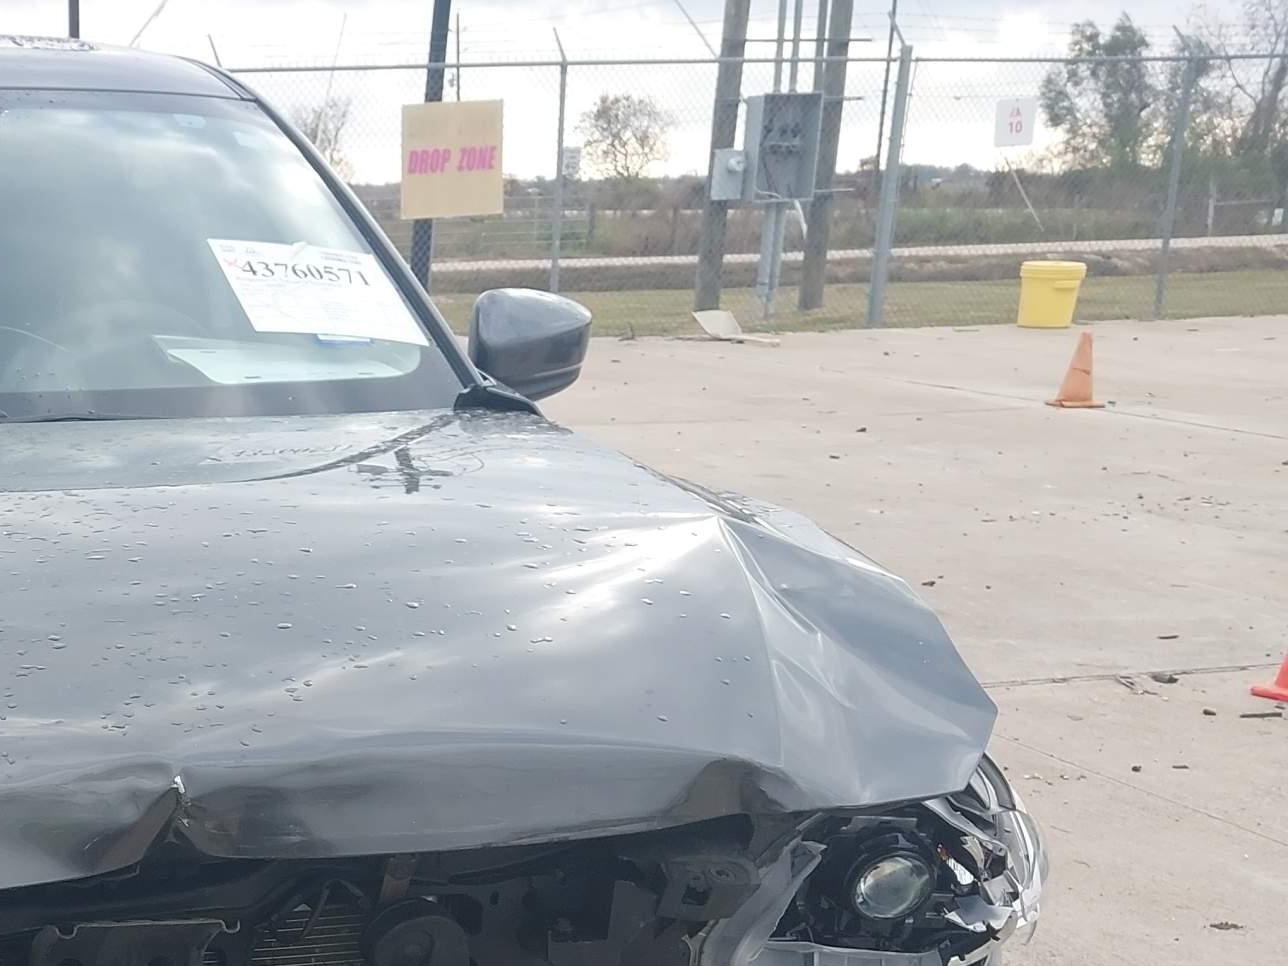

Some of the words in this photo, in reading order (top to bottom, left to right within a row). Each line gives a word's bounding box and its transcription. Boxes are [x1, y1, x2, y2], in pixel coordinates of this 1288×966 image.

[1008, 120, 1023, 134] 10
[407, 148, 452, 175] DROP
[456, 145, 497, 172] ZONE
[241, 260, 371, 286] 43760571
